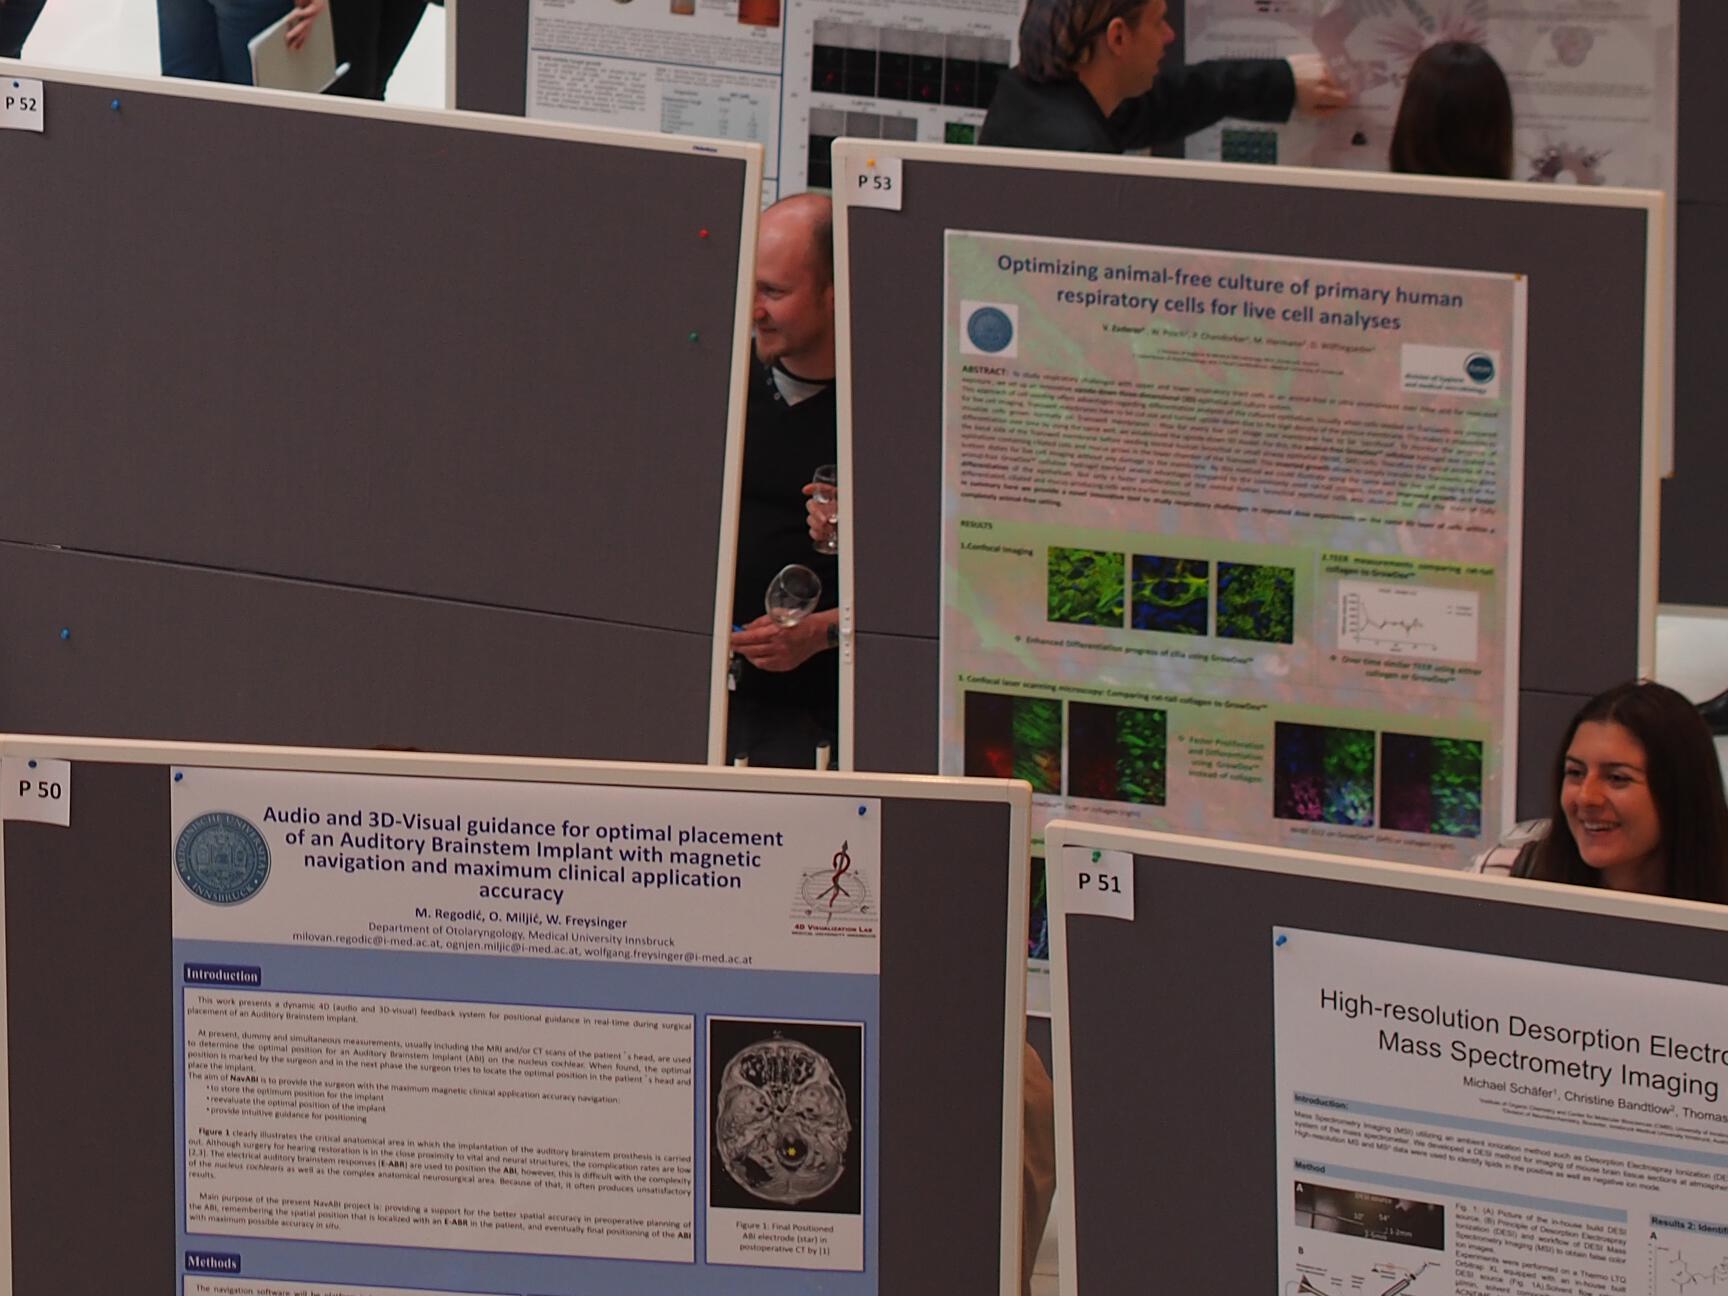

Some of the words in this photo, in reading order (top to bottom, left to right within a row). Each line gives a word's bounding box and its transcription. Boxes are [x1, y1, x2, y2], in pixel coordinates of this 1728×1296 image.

[6, 96, 15, 110] P
[20, 97, 36, 111] 52
[858, 174, 868, 188] P
[873, 175, 891, 190] 53
[997, 254, 1098, 282] Optimizing
[1103, 264, 1212, 288] animal-free
[1217, 273, 1284, 294] culture
[1290, 278, 1310, 295] of
[1314, 281, 1390, 305] primary
[1396, 286, 1463, 308] human
[1056, 289, 1159, 314] respiratory
[1164, 296, 1205, 314] cells
[1210, 298, 1238, 316] for
[1243, 301, 1276, 320] live
[1281, 306, 1313, 322] cell
[1319, 310, 1401, 331] analyses
[19, 780, 31, 796] P
[38, 781, 61, 799] 50
[263, 806, 320, 825] Audio
[326, 810, 362, 827] and
[368, 811, 461, 832] 3D-Visual
[467, 817, 557, 841] guidance
[562, 819, 591, 839] for
[596, 822, 671, 846] optimal
[678, 825, 784, 850] placement
[285, 828, 305, 845] of
[310, 833, 334, 847] an
[340, 832, 425, 855] Auditory
[431, 836, 530, 857] Brainstem
[537, 841, 613, 866] Implant
[618, 845, 663, 865] with
[669, 847, 760, 873] magnetic
[304, 852, 405, 873] navigation
[411, 857, 447, 874] and
[454, 860, 551, 879] maximum
[558, 863, 624, 883] clinical
[631, 868, 741, 888] application
[1078, 872, 1091, 889] P
[1098, 874, 1121, 894] 51
[479, 885, 564, 905] accuracy
[415, 907, 431, 918] M.
[565, 915, 627, 930] Freysinger
[187, 967, 257, 982] Introduction
[1320, 987, 1499, 1034] High-resolution
[1509, 1015, 1640, 1053] Desorption
[1379, 1029, 1442, 1058] Mass
[1450, 1040, 1612, 1087] Spectrometry
[1622, 1063, 1718, 1103] Imaging
[188, 1255, 236, 1268] Methods
